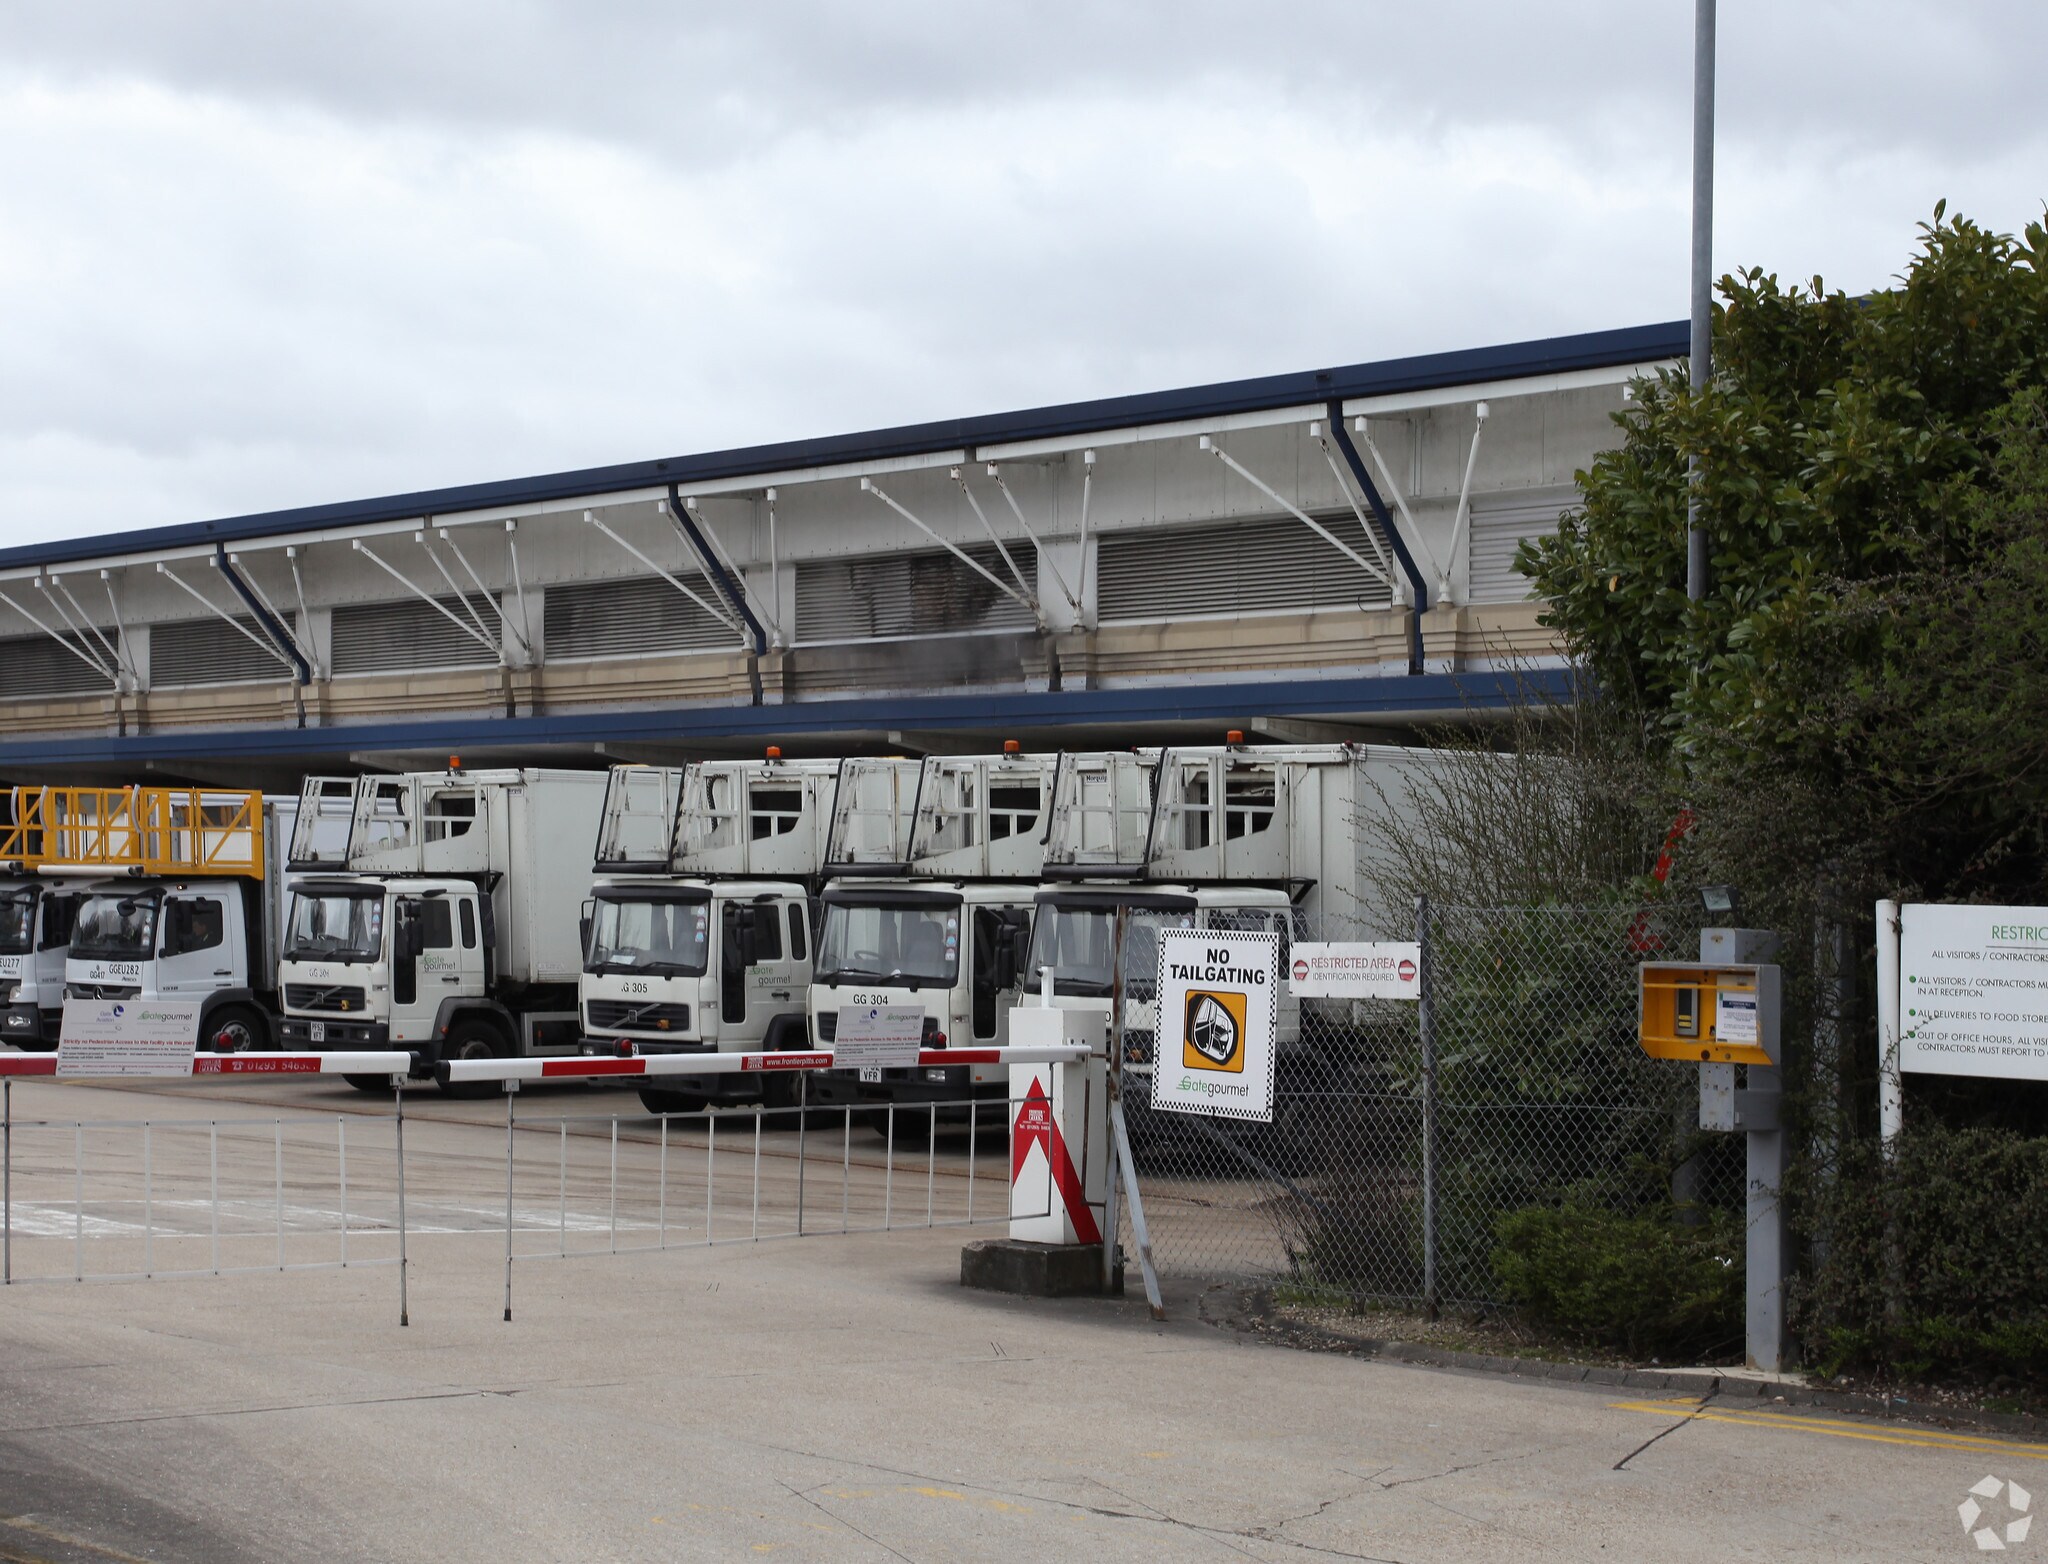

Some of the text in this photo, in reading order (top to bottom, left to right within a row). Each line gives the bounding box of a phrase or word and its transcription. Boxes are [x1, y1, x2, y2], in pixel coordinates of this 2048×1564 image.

[1206, 948, 1230, 964] NO
[1931, 950, 1944, 959] ALL
[1946, 951, 1980, 960] VISITORS
[1989, 952, 2048, 963] CONTRACTORS
[109, 963, 140, 975] GGEU282
[1311, 957, 1396, 969] RESTRICTED AREA
[758, 974, 791, 987] gourmet
[1170, 964, 1265, 985] TAILGATING
[1312, 972, 1395, 981] IDENTIFICATION REQUIRED
[632, 982, 648, 993] 305
[1918, 976, 1930, 985] ALL
[1932, 977, 1967, 986] VISITORS
[1975, 979, 2036, 989] CONTRACTORS
[1917, 987, 1927, 995] IN
[1928, 988, 1938, 996] AT
[853, 994, 888, 1005] GG 304
[1918, 1010, 1931, 1018] ALL
[1933, 1010, 1977, 1020] DELIVERIES
[1980, 1012, 1991, 1021] TO
[1993, 1012, 2019, 1022] FOOD
[1917, 1031, 1934, 1040] OUT
[1937, 1032, 1949, 1041] OF
[1951, 1033, 1980, 1043] OFFICE
[1983, 1034, 2015, 1045] HOURS,
[2018, 1036, 2031, 1045] ALL
[1917, 1042, 1976, 1053] CONTRACTORS
[1977, 1045, 2000, 1055] MUST
[2001, 1046, 2031, 1056] REPORT
[2034, 1048, 2046, 1057] TO
[766, 1057, 828, 1066] www.frontierpitts.com
